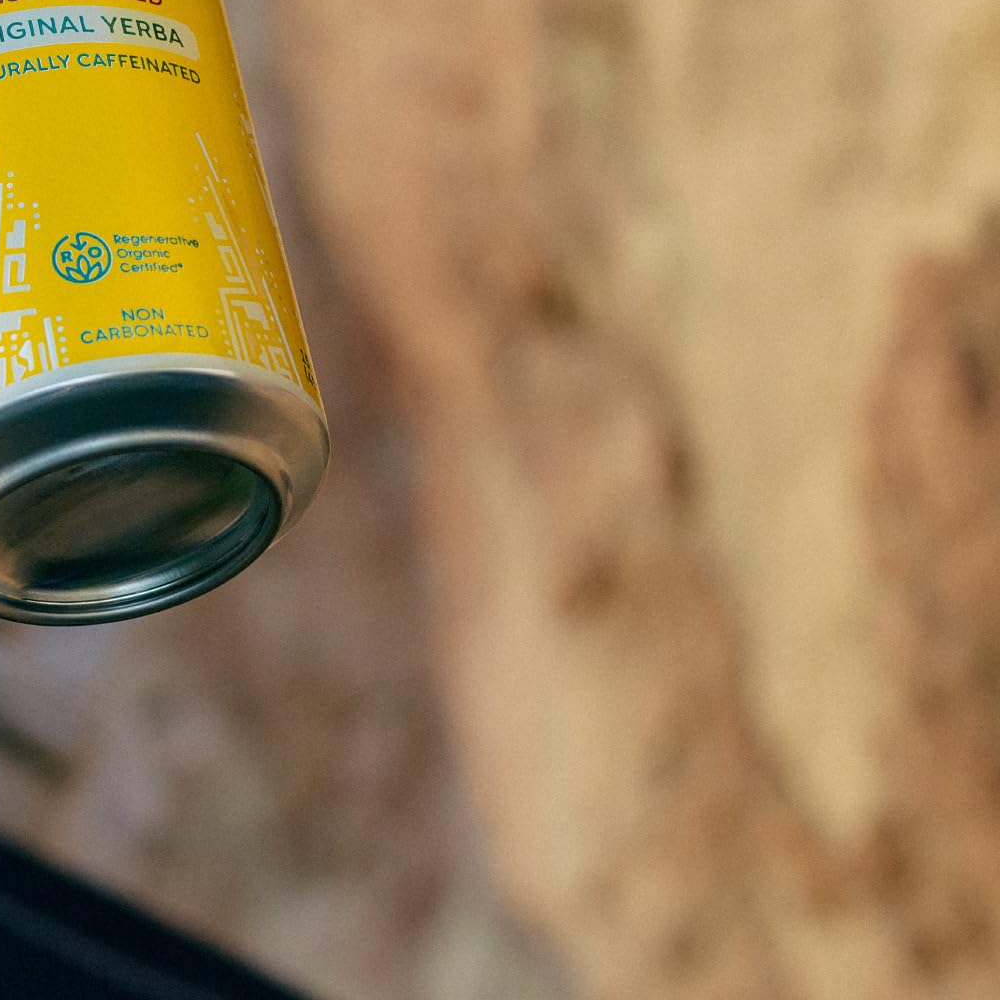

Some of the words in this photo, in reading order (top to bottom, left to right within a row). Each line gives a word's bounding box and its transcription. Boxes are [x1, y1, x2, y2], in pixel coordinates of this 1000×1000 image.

[100, 15, 185, 48] YERBA
[76, 53, 201, 85] CAFFEINATED
[113, 234, 200, 248] Regenerative
[117, 248, 171, 261] Organic
[121, 307, 165, 322] NON
[80, 323, 209, 344] CARBONATED
